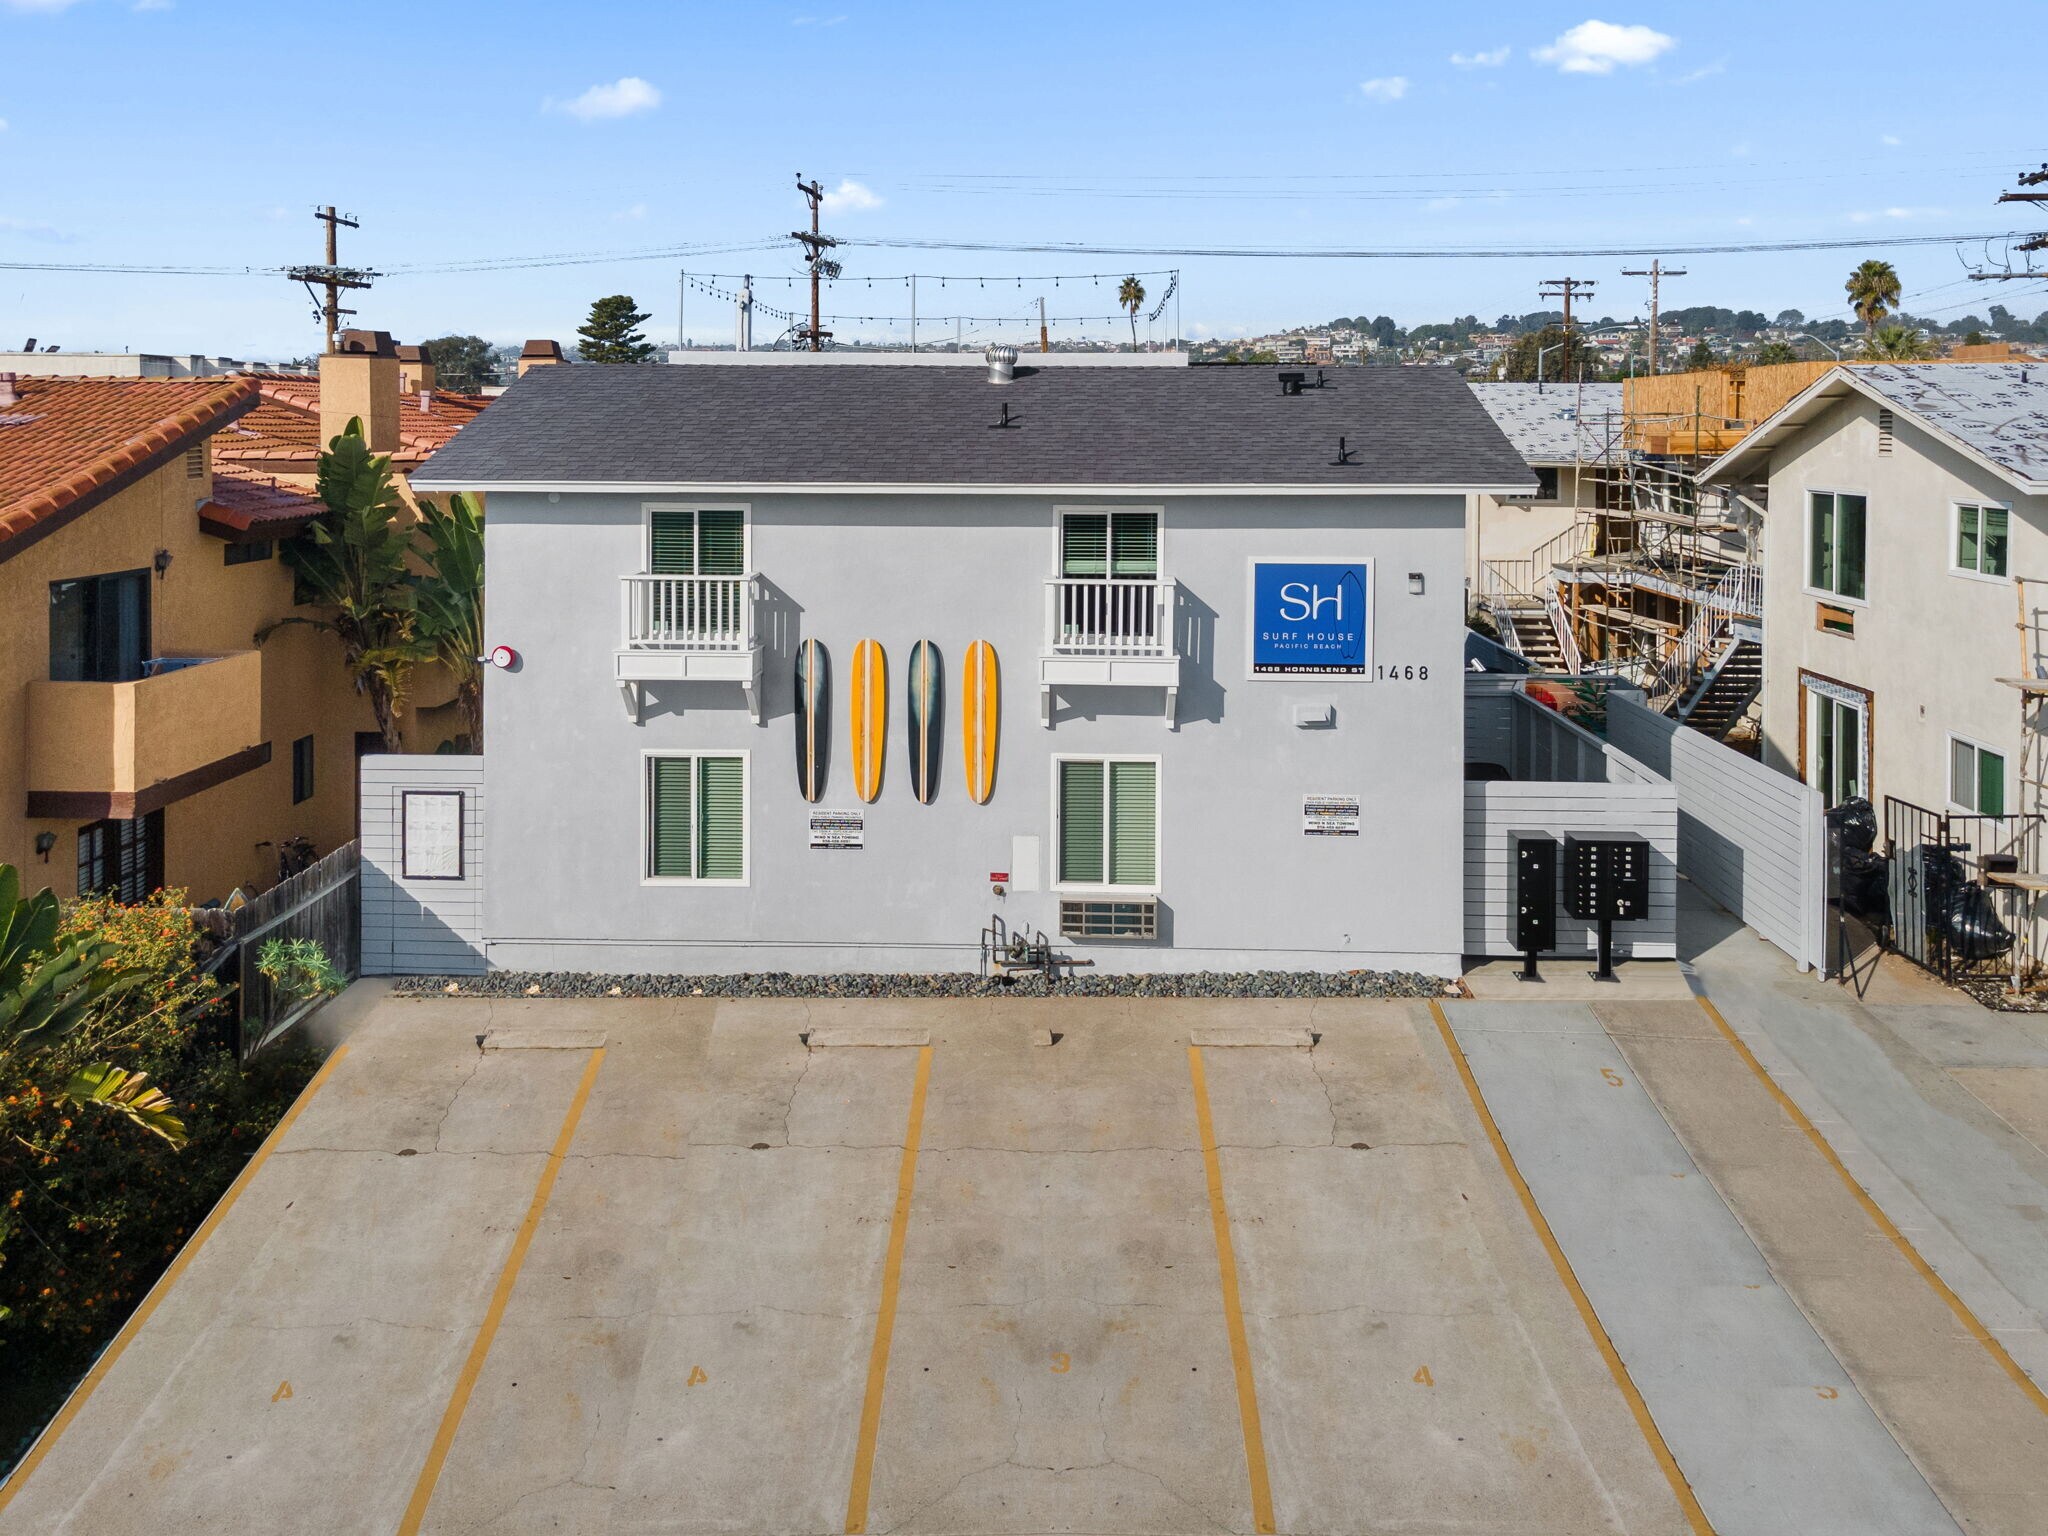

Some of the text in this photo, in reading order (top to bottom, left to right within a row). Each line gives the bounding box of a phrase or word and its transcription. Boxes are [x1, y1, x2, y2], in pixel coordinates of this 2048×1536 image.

[1279, 582, 1342, 621] SH
[1262, 632, 1354, 641] SURF HOUSE
[1378, 665, 1429, 680] 1468
[1600, 1068, 1623, 1087] 5
